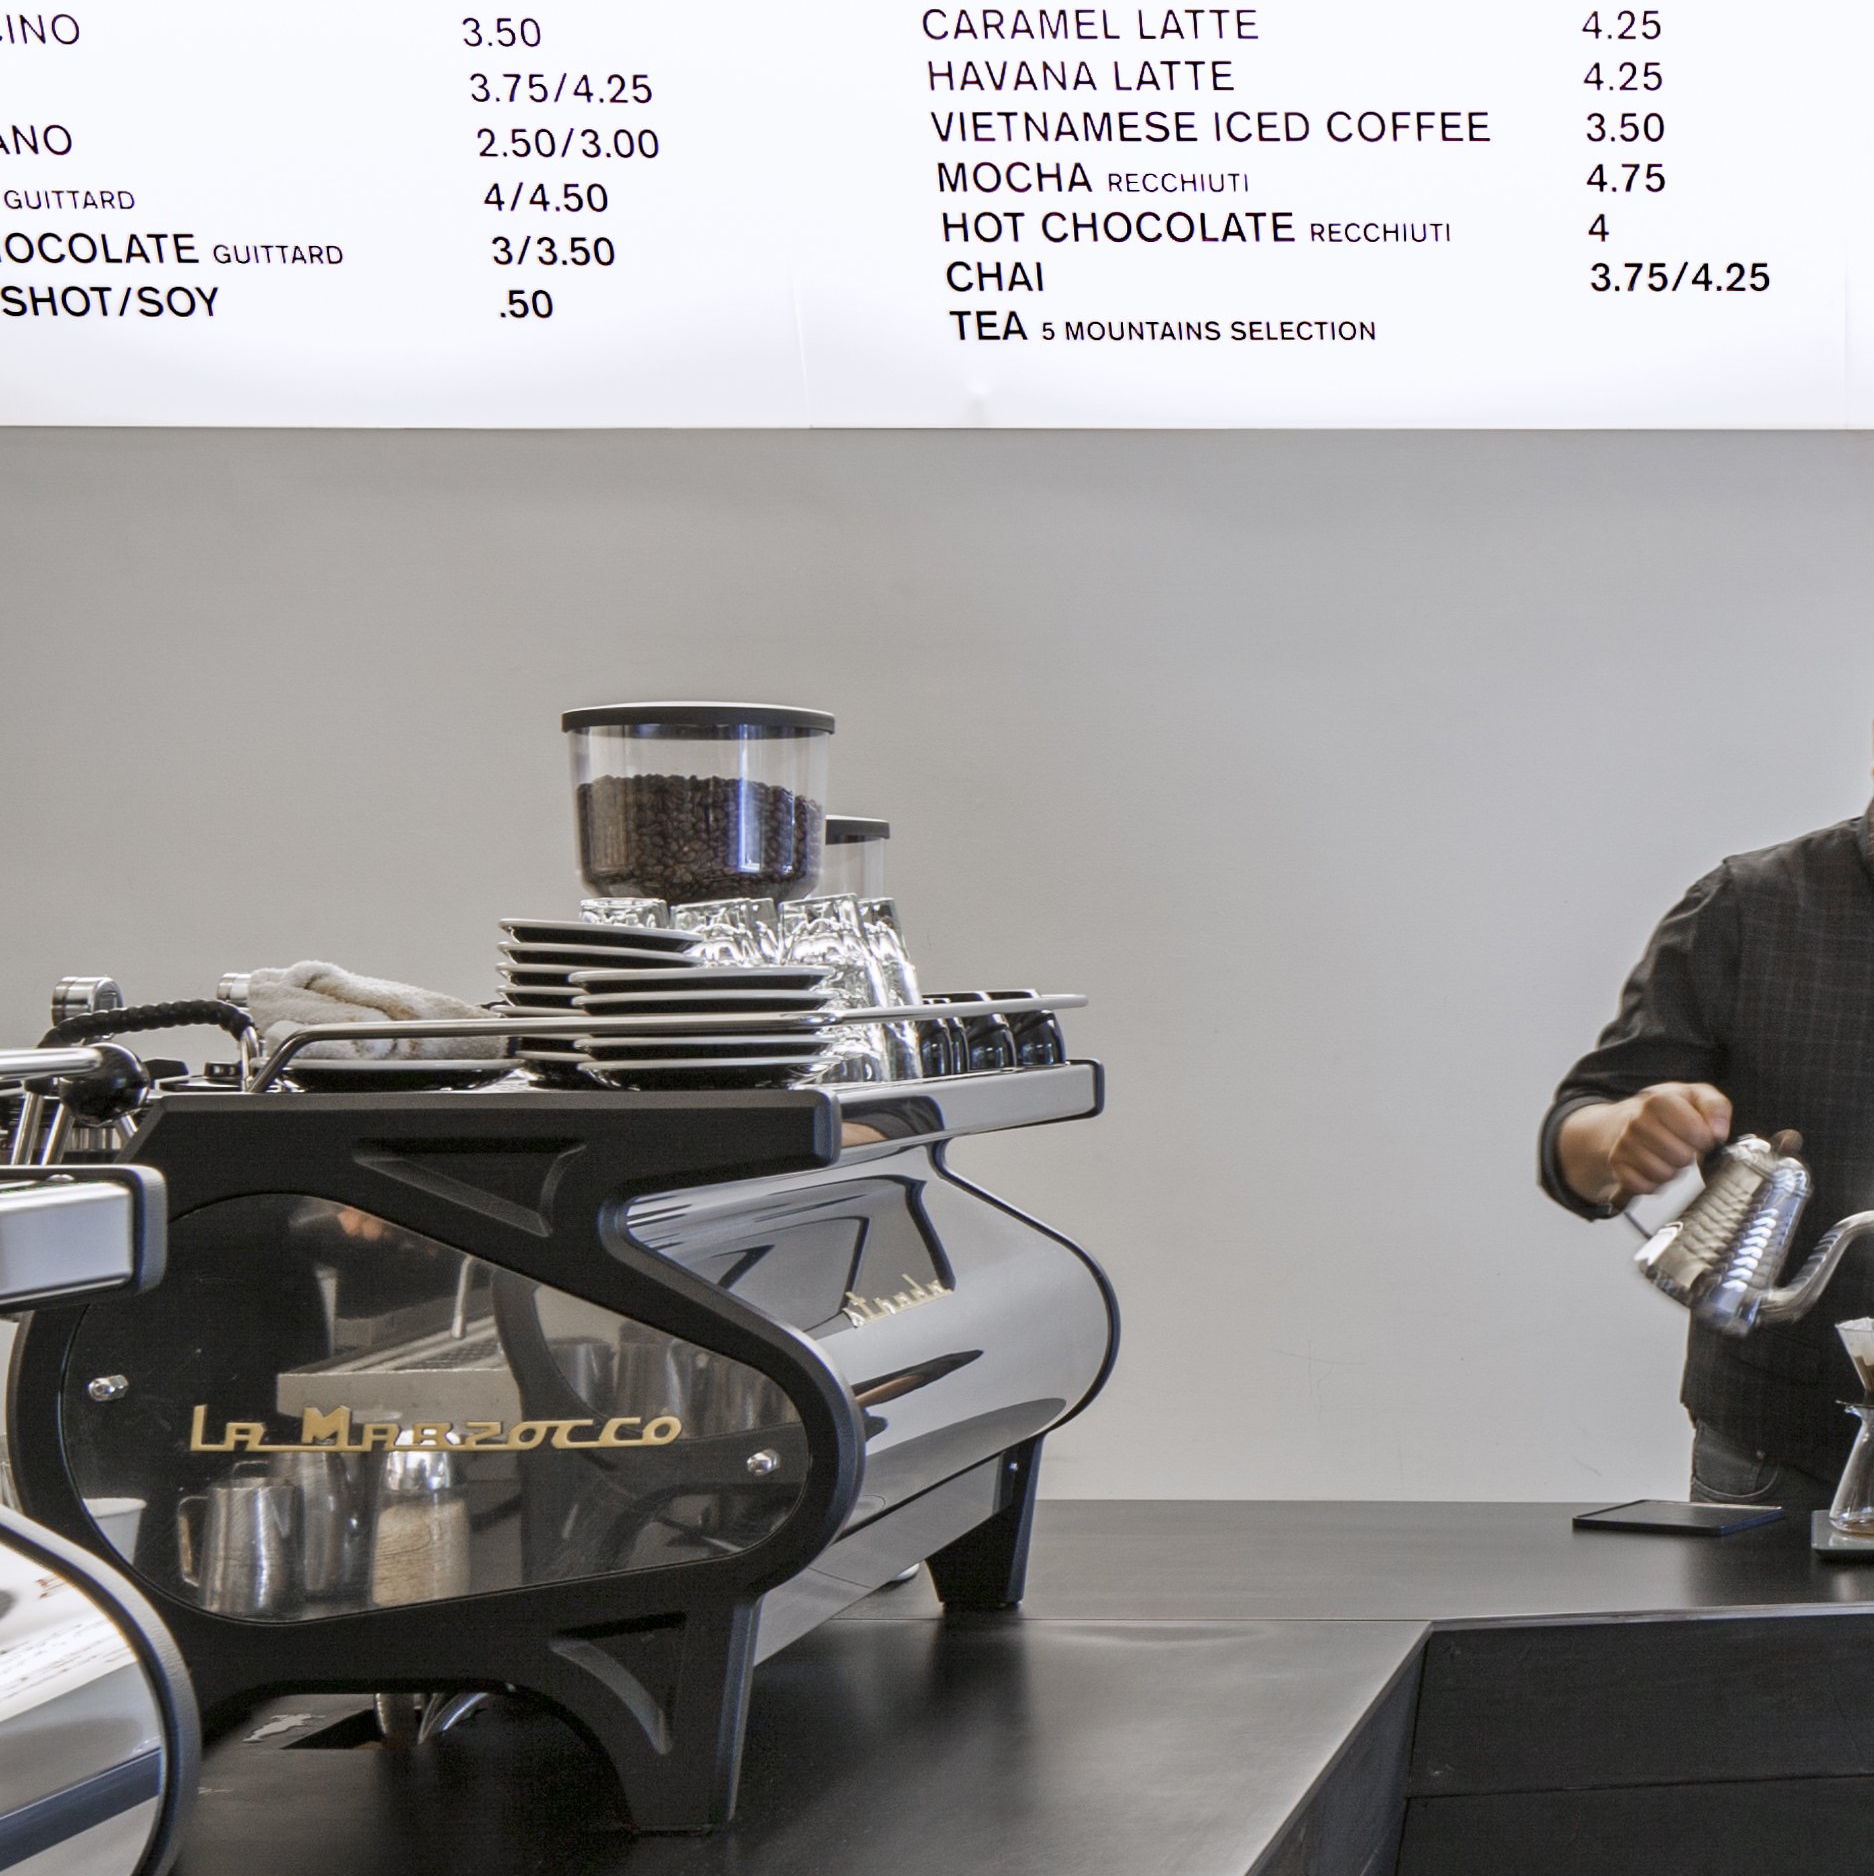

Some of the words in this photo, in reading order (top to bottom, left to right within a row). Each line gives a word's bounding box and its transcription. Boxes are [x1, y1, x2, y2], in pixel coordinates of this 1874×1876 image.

[462, 17, 541, 47] 3.50
[922, 9, 1120, 40] CARAMEL
[1138, 9, 1258, 39] LATTE
[1582, 10, 1661, 40] 4.25
[470, 73, 652, 104] 3.75/4.25
[928, 61, 1097, 91] HAVANA
[1114, 61, 1234, 91] LATTE
[1583, 62, 1662, 91] 4.25
[930, 111, 1198, 142] VIETNAMESE
[1215, 111, 1309, 142] ICED
[1327, 111, 1491, 142] COFFEE
[1587, 113, 1664, 142] 3.50
[477, 128, 659, 159] 2.50/3.00
[937, 161, 1093, 193] MOCHA
[1108, 173, 1248, 193] RECCHIUTI
[1586, 163, 1665, 193] 4.75
[4, 190, 135, 209] GUITTARD
[484, 182, 608, 212] 4/4.50
[942, 212, 1025, 243] HOT
[1041, 211, 1295, 243] CHOCOLATE
[1310, 223, 1450, 242] RECCHIUTI
[1588, 214, 1609, 242] 4
[0, 232, 199, 264] OCOLATE
[213, 244, 343, 264] GUITTARD
[492, 236, 615, 266] 3/3.50
[946, 261, 1044, 292] CHAI
[1591, 261, 1770, 292] 3.75/4.25
[0, 285, 219, 317] SHOT/SOY
[500, 290, 553, 319] .50
[949, 310, 1028, 341] TEA
[1042, 322, 1055, 340] 5
[1065, 321, 1221, 341] MOUNTAINS
[1231, 321, 1375, 341] SELECTION
